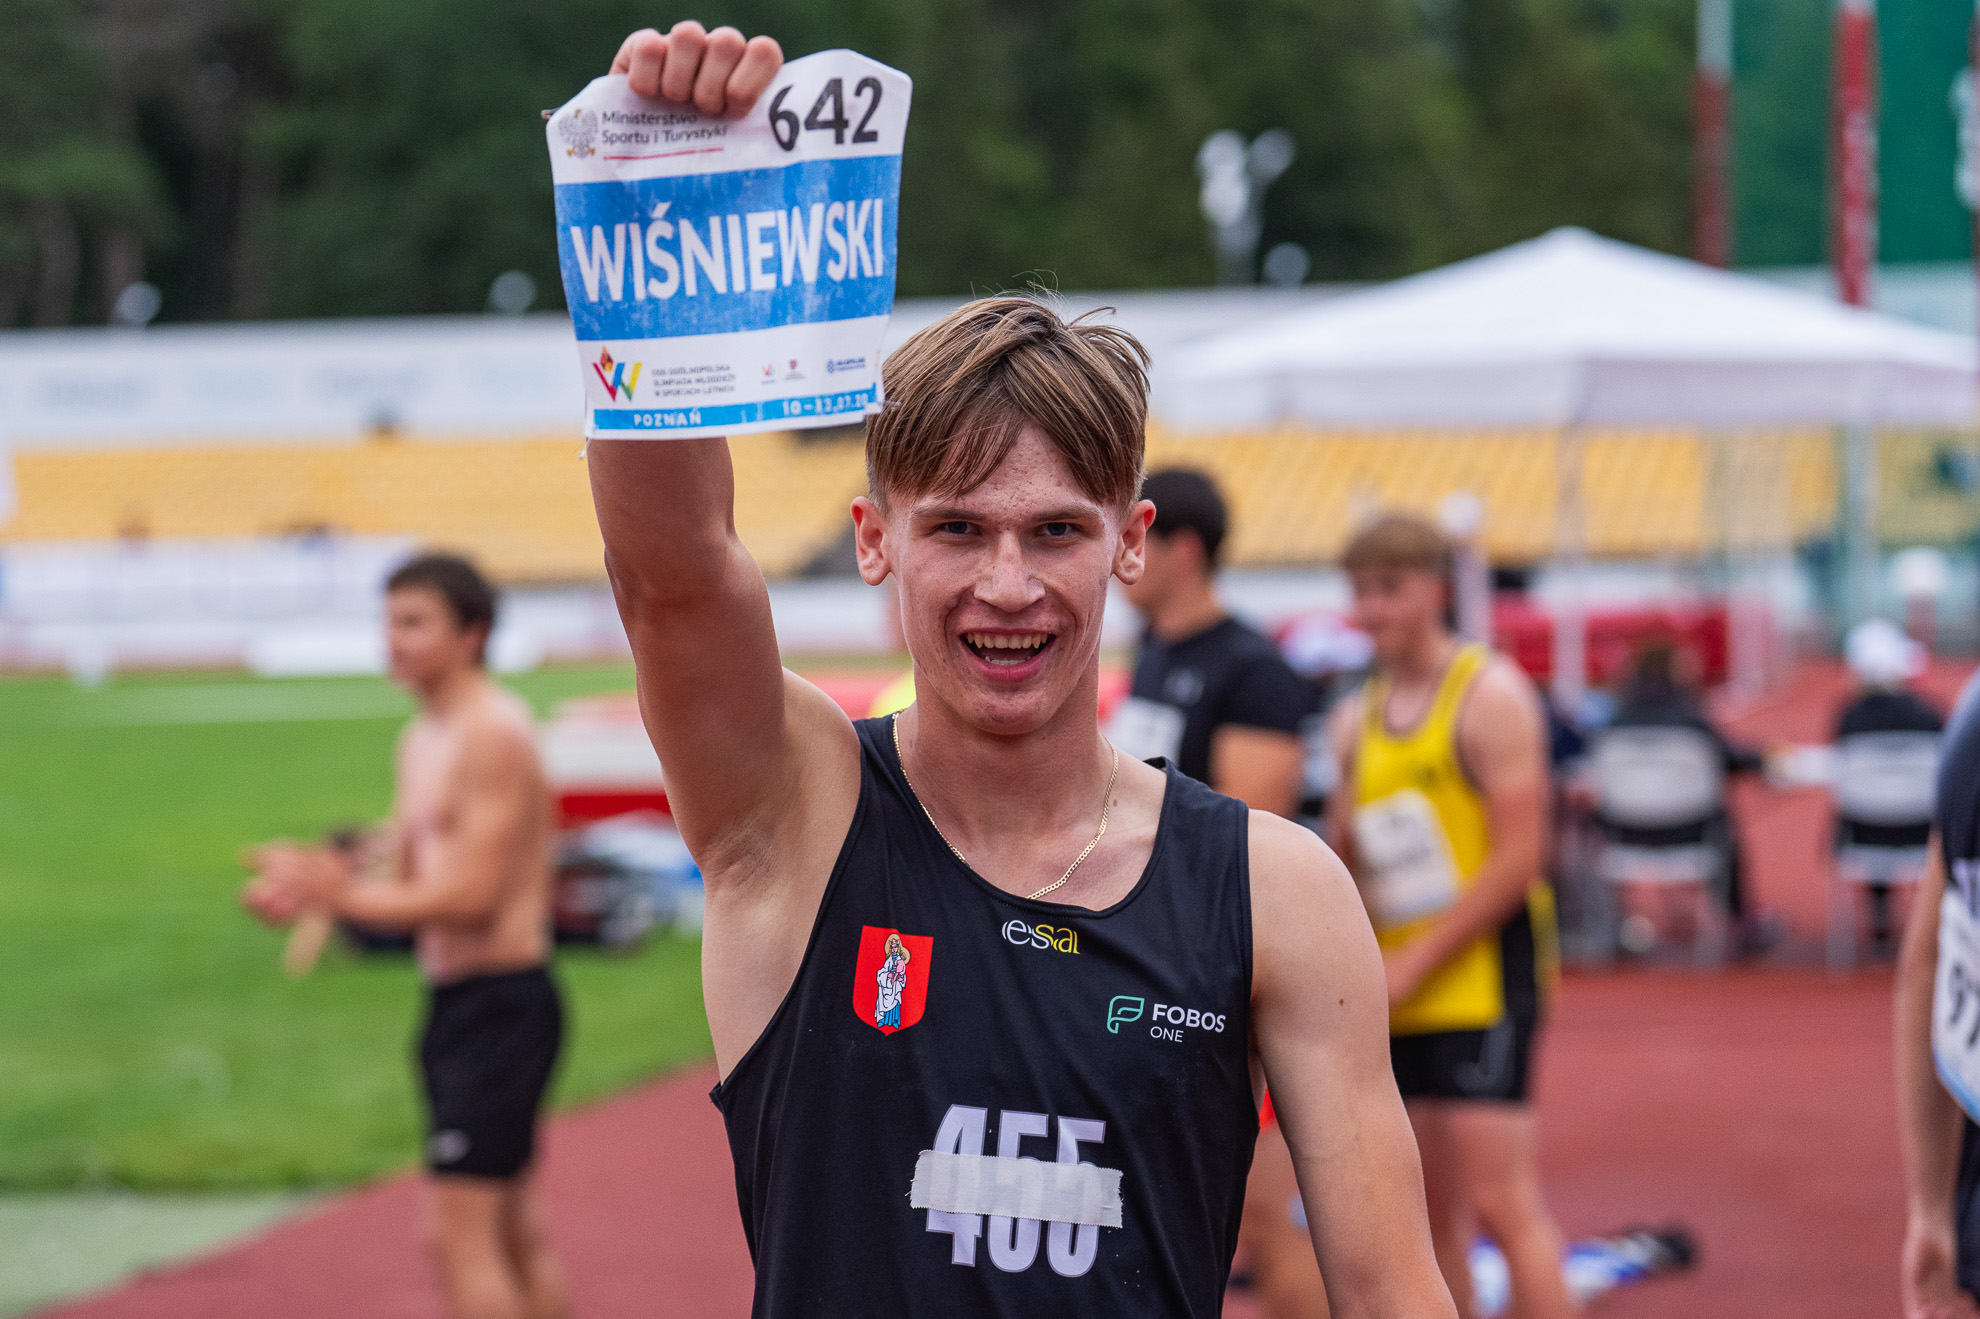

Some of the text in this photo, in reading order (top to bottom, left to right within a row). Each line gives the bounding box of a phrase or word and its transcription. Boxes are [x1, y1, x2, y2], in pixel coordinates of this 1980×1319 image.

[602, 111, 697, 126] Ministerstwo
[769, 76, 883, 151] 642
[602, 125, 727, 145] Sportu i Turystyki
[570, 199, 884, 302] WIŚNIEWSKI
[633, 406, 702, 427] POZNAŃ
[1151, 1003, 1226, 1033] FOBOS
[1150, 1026, 1184, 1043] ONE
